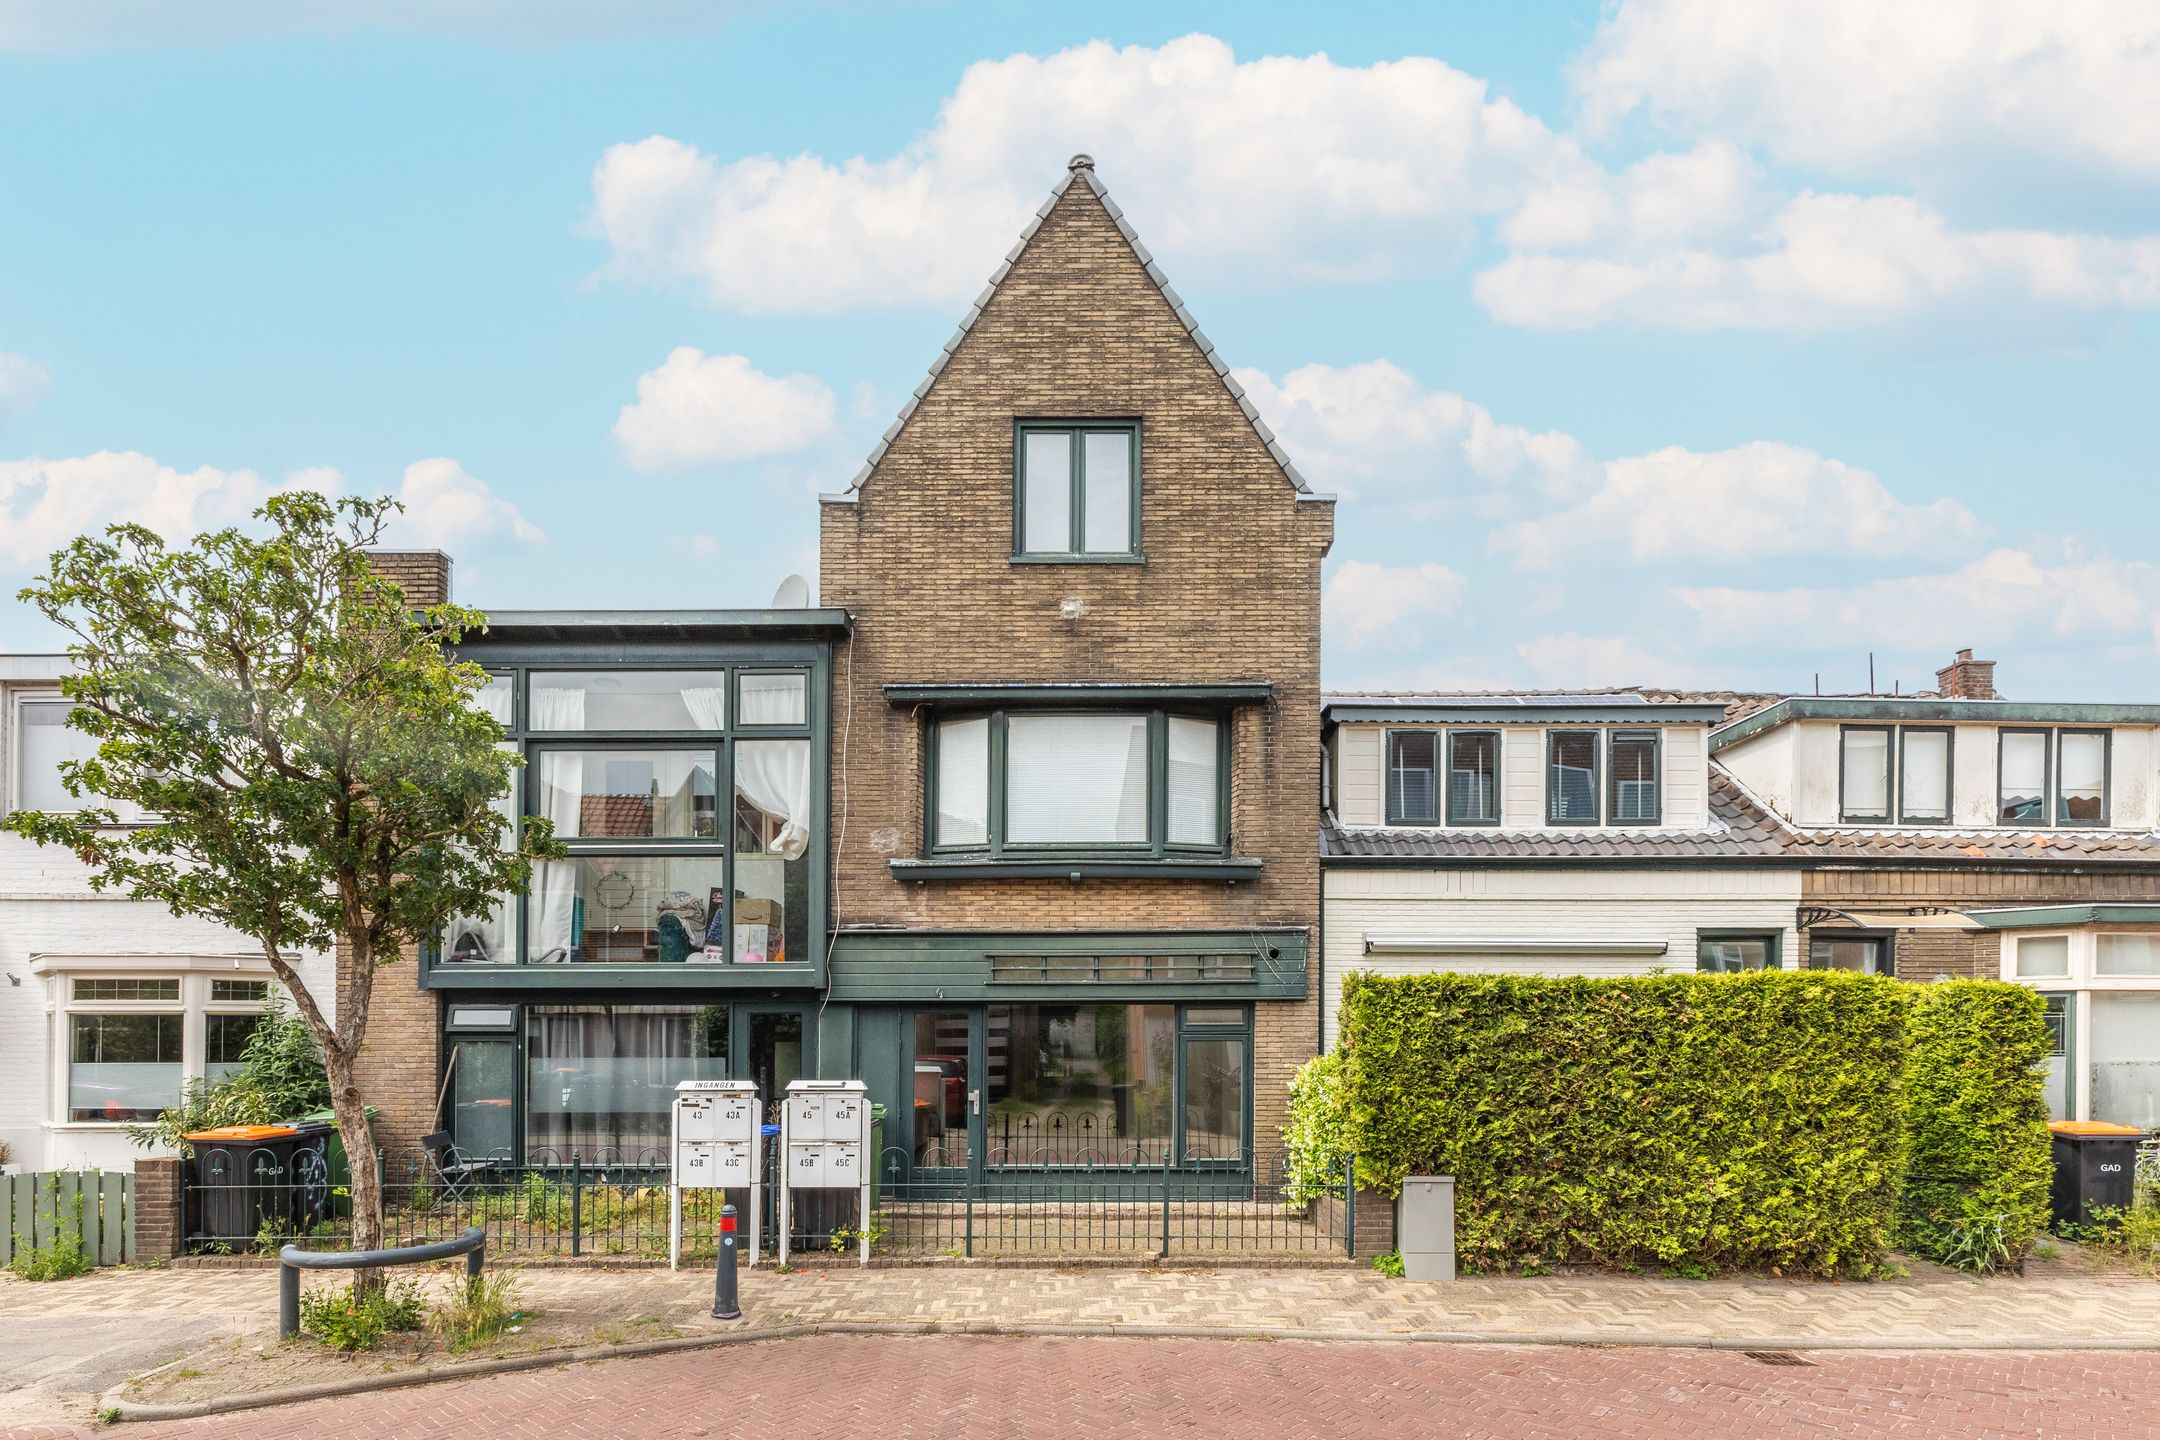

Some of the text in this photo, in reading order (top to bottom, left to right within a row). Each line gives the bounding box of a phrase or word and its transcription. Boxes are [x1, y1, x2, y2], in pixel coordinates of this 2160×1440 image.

[694, 1081, 736, 1089] INGANGEN
[692, 1111, 703, 1119] 43
[725, 1111, 740, 1119] 43A
[802, 1111, 812, 1119] 45
[836, 1111, 851, 1119] 45A
[689, 1159, 704, 1167] 43B
[725, 1159, 740, 1167] 43C
[799, 1159, 814, 1167] 45B
[835, 1159, 850, 1167] 45C
[2100, 1164, 2121, 1172] GAD
